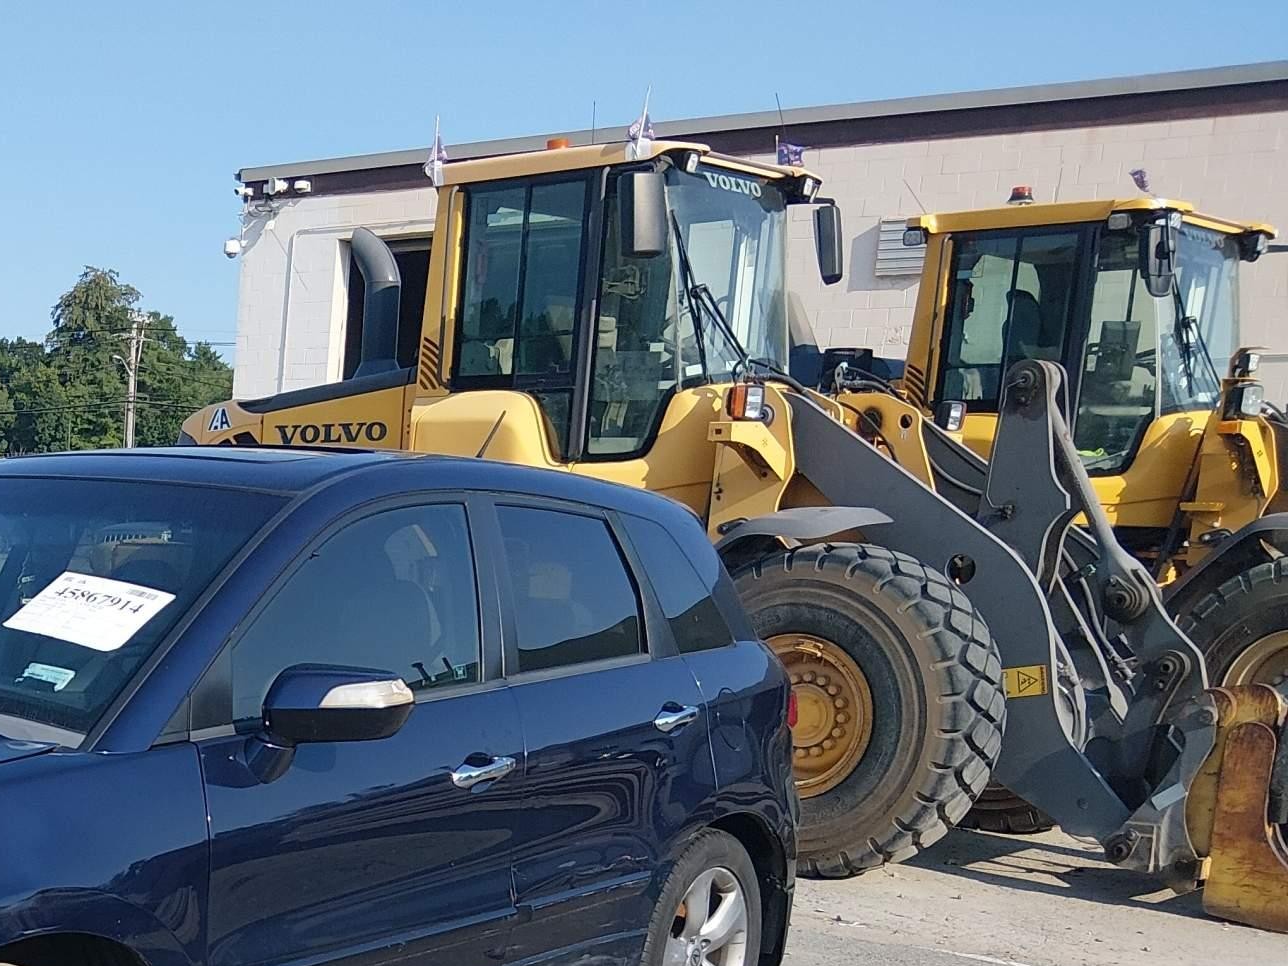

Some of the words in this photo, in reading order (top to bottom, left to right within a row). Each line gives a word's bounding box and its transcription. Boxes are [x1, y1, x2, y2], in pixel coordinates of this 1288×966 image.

[703, 172, 762, 197] VOLVO
[275, 421, 387, 445] VOLVO
[54, 586, 145, 614] 45867914
